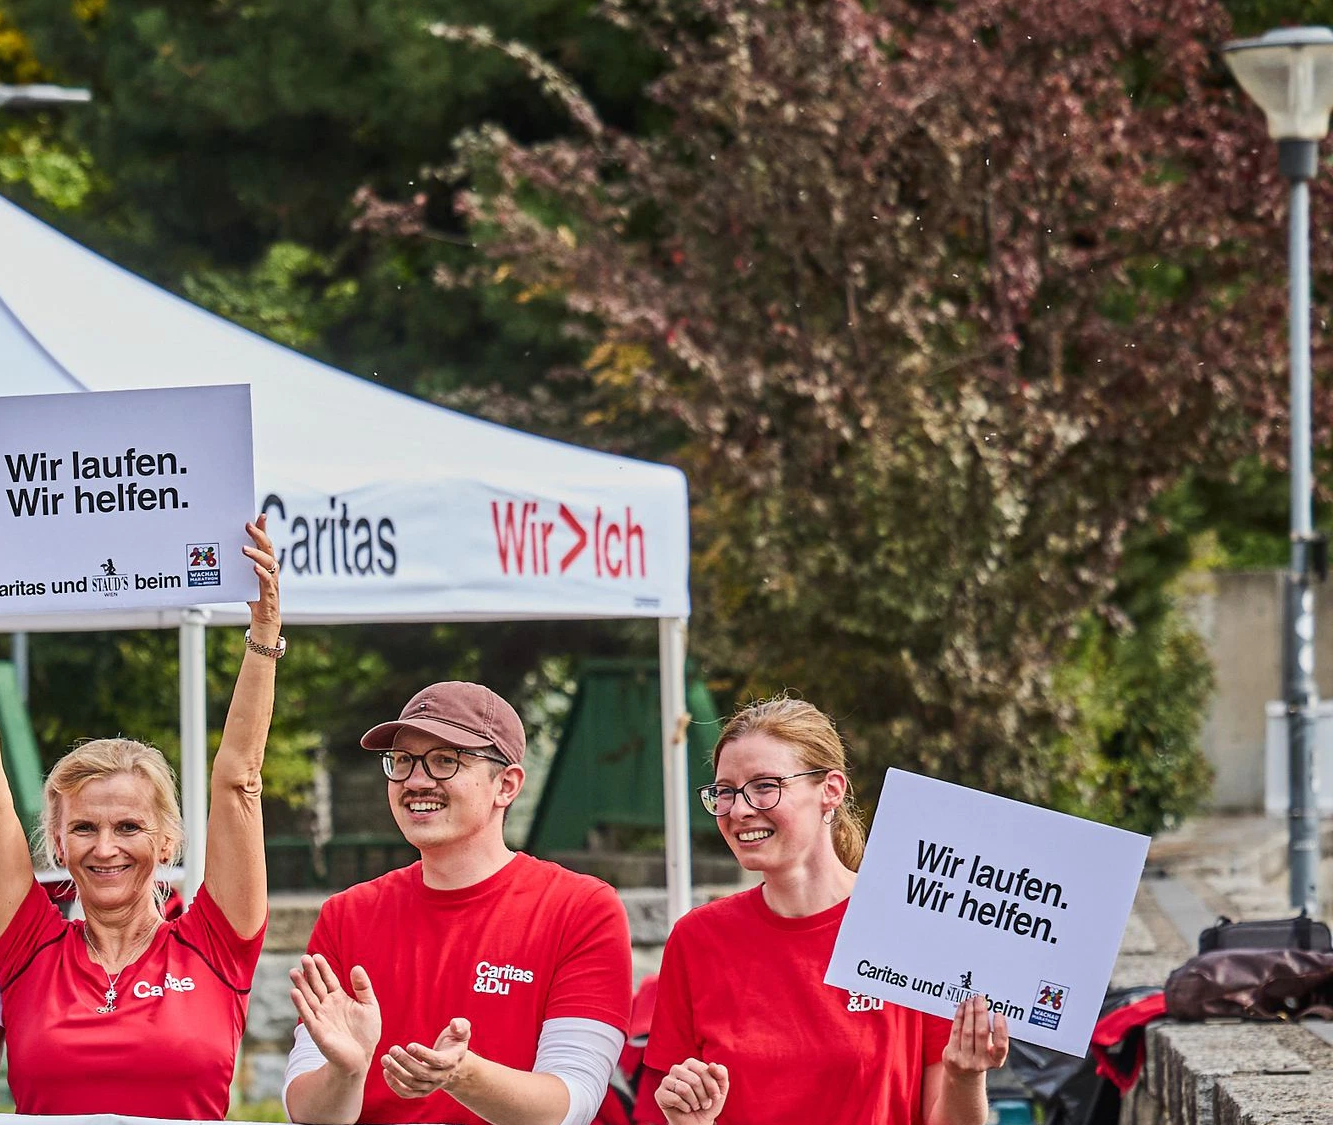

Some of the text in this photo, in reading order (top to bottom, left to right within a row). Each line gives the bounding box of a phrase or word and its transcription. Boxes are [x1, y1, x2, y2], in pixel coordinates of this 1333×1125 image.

[4, 447, 187, 483] Wir laufen.
[5, 482, 189, 517] Wir helfen.
[261, 493, 398, 577] Caritas
[51, 577, 87, 594] und
[92, 576, 129, 593] STAUD'S
[135, 572, 181, 590] beim
[915, 839, 1069, 910] Wir laufen.
[906, 873, 1058, 945] Wir helfen.
[473, 976, 510, 995] &Du
[475, 961, 534, 984] Caritas
[856, 959, 909, 988] Caritas
[911, 976, 945, 998] und
[985, 993, 1025, 1021] beim
[846, 995, 884, 1012] &Du
